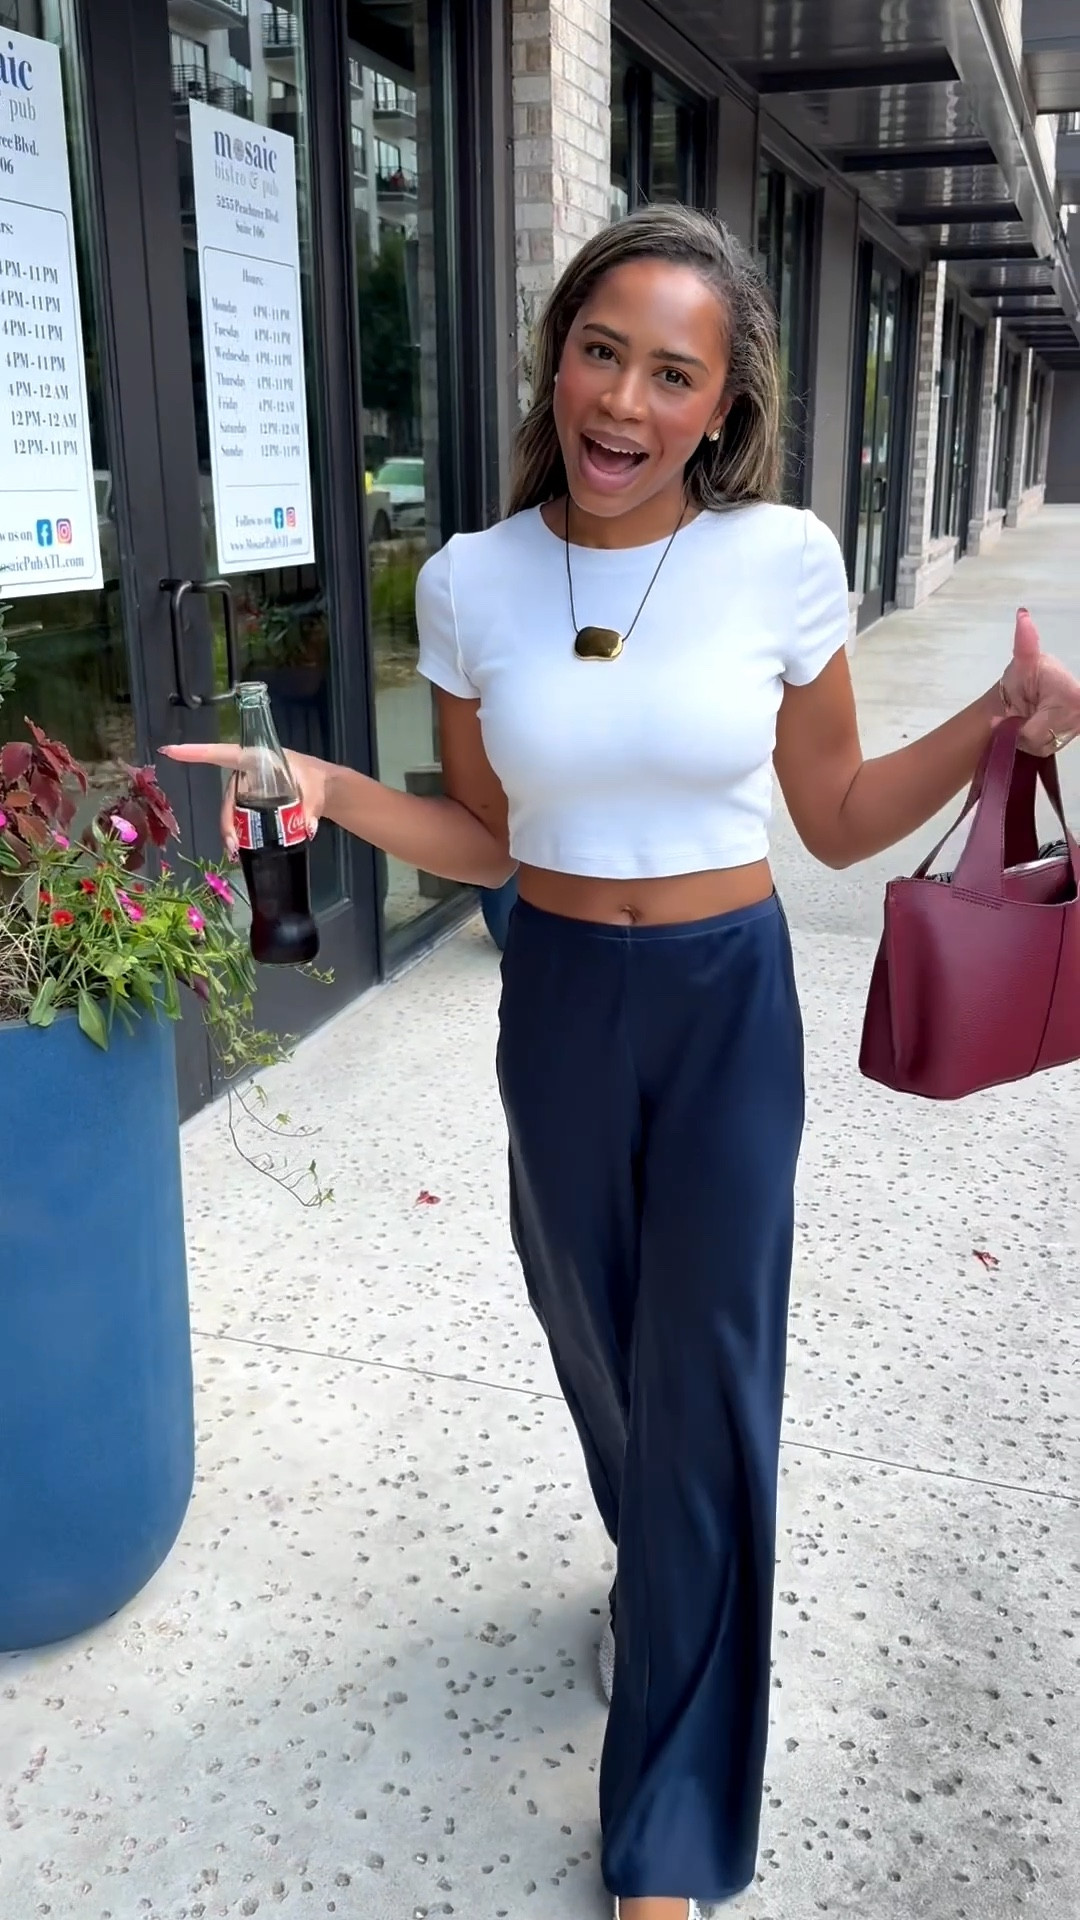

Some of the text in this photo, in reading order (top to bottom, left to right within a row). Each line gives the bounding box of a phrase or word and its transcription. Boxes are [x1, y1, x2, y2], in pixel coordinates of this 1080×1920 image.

[9, 97, 36, 122] pub
[14, 133, 39, 156] Blvd.
[214, 131, 277, 174] mosaic
[214, 160, 246, 186] bistro
[262, 179, 279, 199] pub
[212, 296, 237, 318] Monday
[214, 322, 239, 341] Tuesday
[215, 346, 250, 365] Wednesday
[216, 371, 246, 390] Thursday
[218, 395, 238, 413] Friday
[219, 420, 247, 437] Saturday
[221, 444, 244, 459] Sunday
[8, 531, 19, 541] us
[20, 531, 33, 541] on
